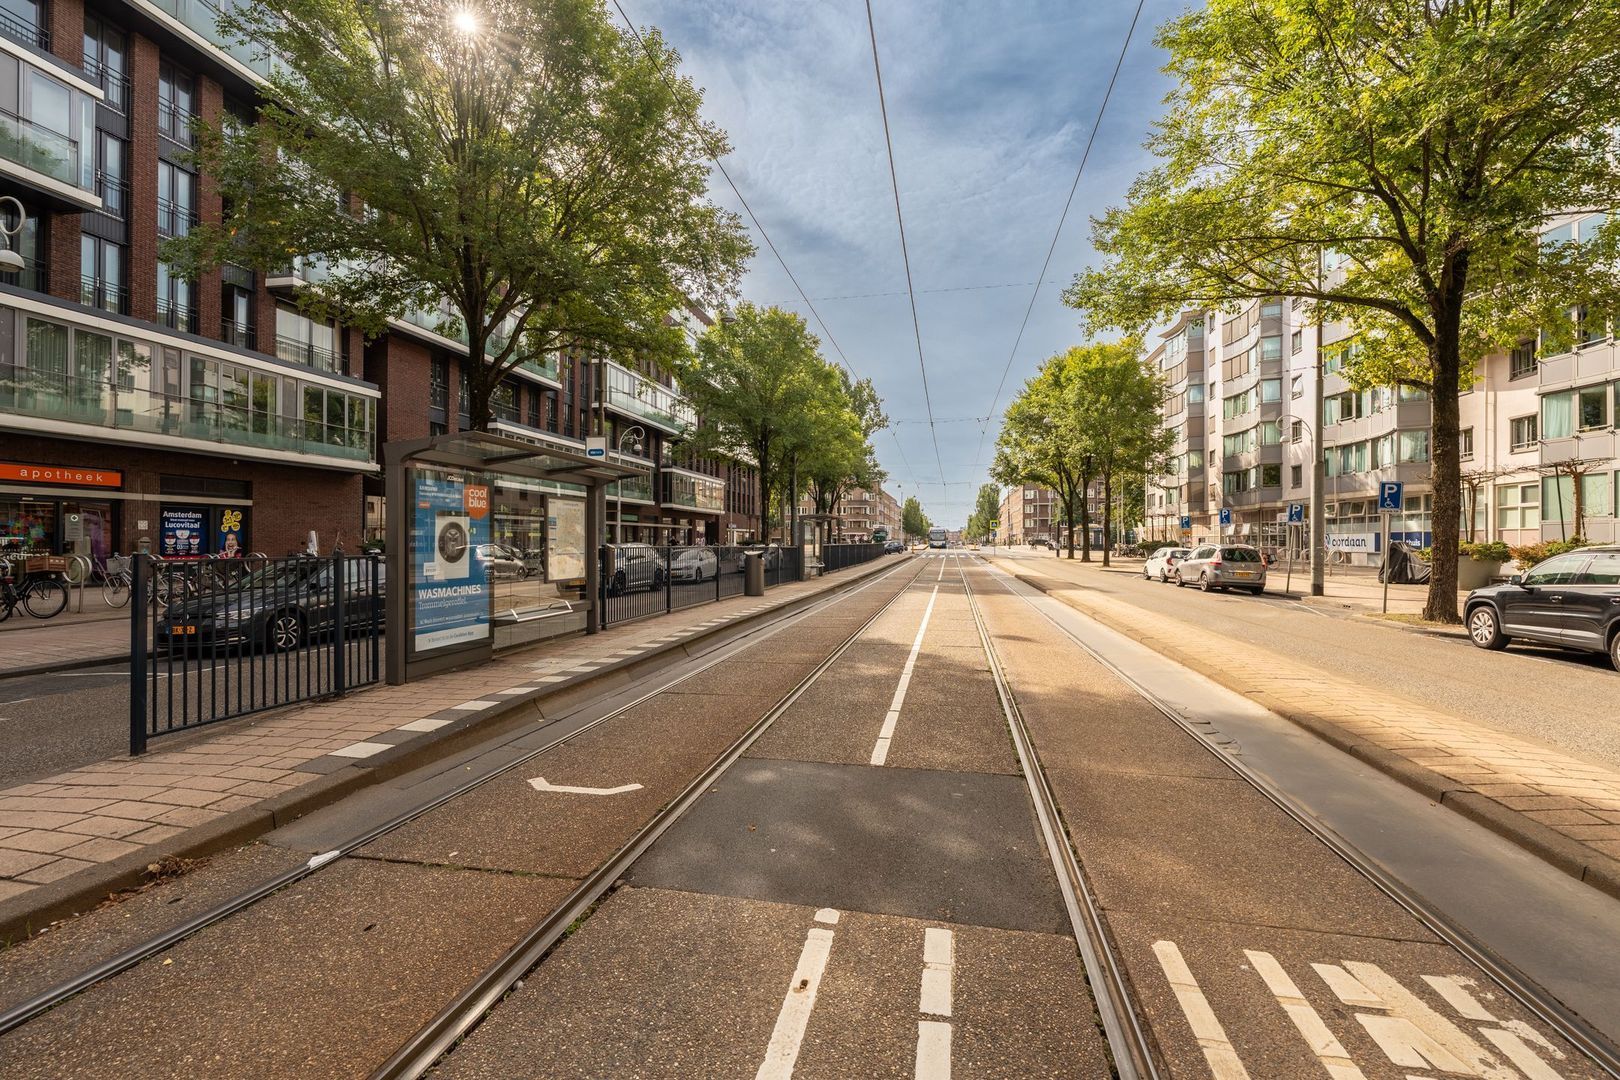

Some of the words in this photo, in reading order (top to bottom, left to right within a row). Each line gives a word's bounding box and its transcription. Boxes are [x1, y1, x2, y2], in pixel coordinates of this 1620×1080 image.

[20, 469, 102, 481] apotheek
[469, 489, 487, 498] cool
[1385, 484, 1397, 497] P
[469, 497, 487, 508] blue
[1222, 510, 1228, 518] P
[1292, 504, 1300, 514] P
[1332, 537, 1367, 547] cordaan
[418, 584, 482, 599] WASMACHINES
